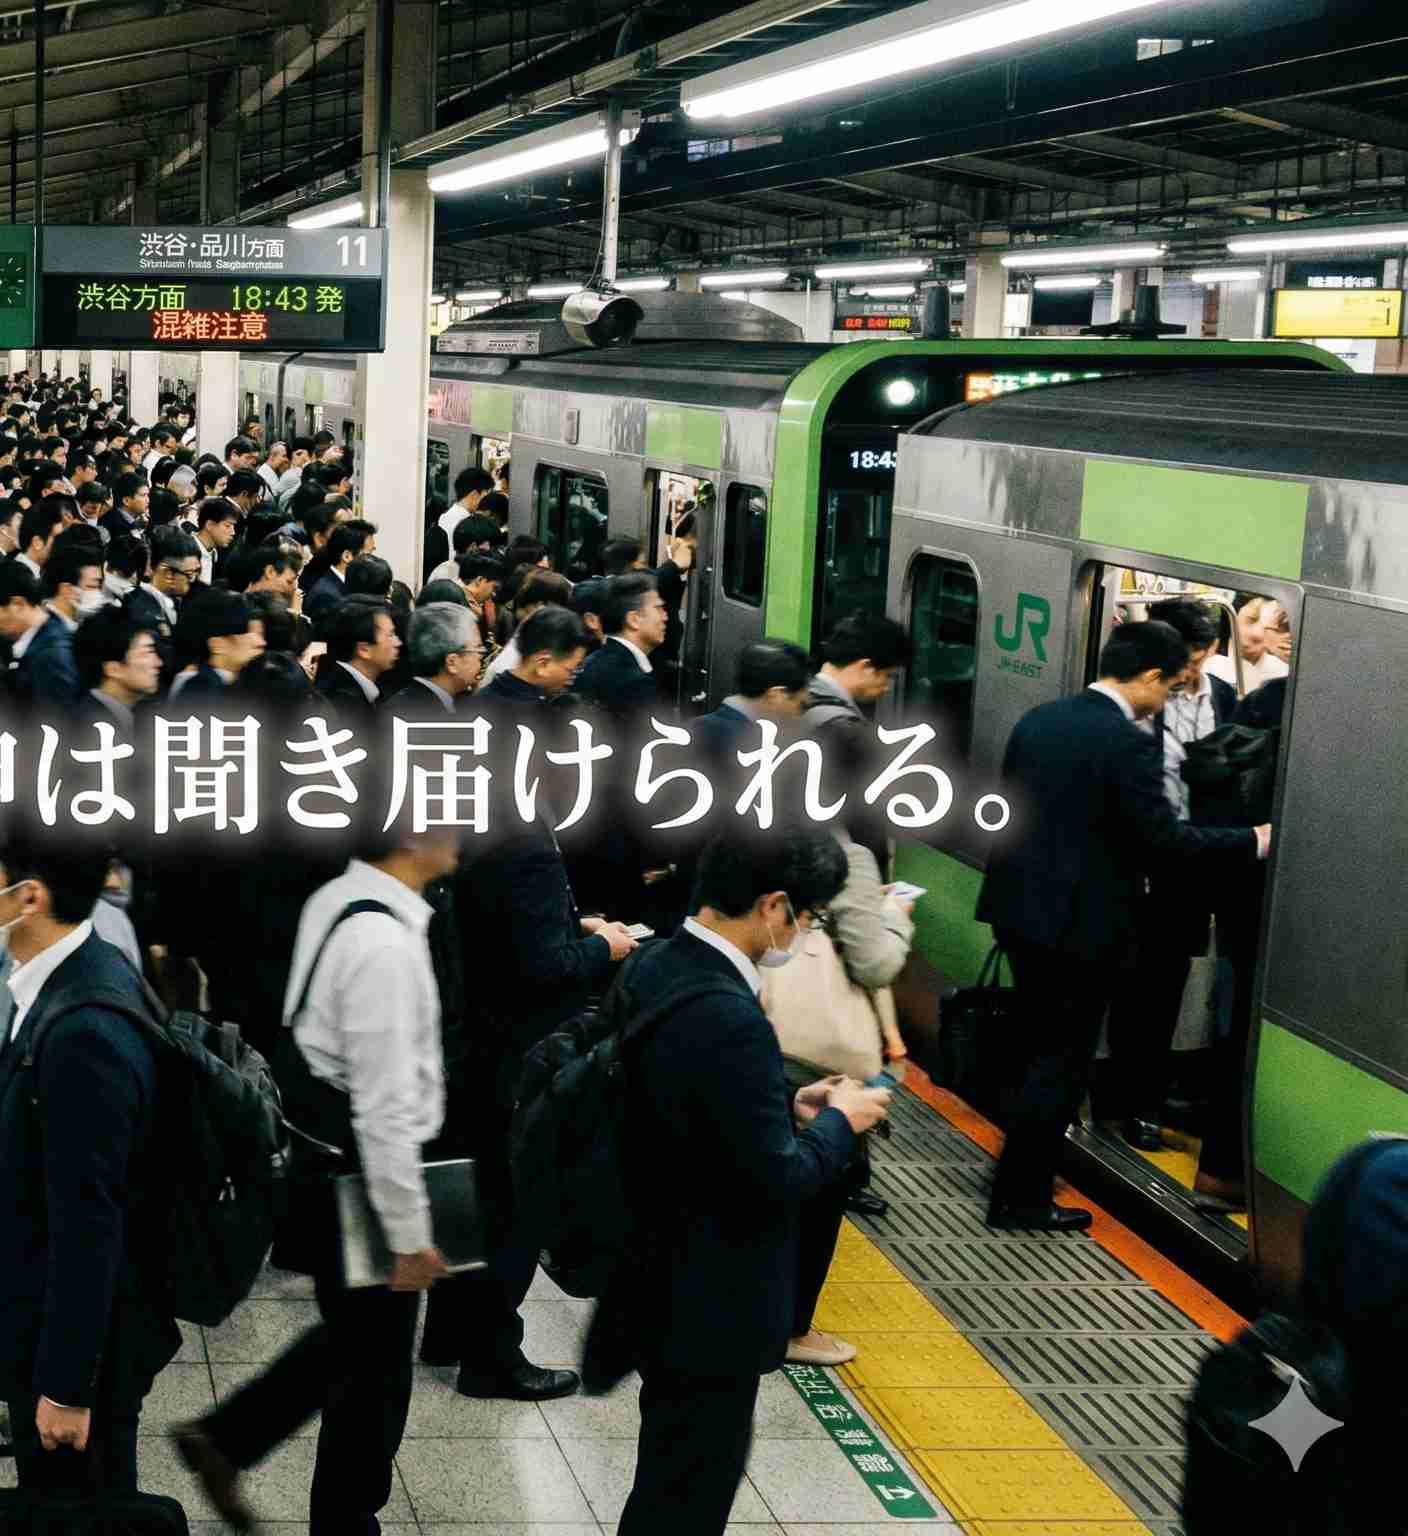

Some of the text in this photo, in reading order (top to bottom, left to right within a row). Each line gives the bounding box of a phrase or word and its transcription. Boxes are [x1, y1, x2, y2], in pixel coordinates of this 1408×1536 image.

[337, 235, 367, 267] 11
[77, 282, 188, 311] 渋谷方面
[152, 310, 267, 340] 混雑注意
[994, 591, 1050, 664] JR
